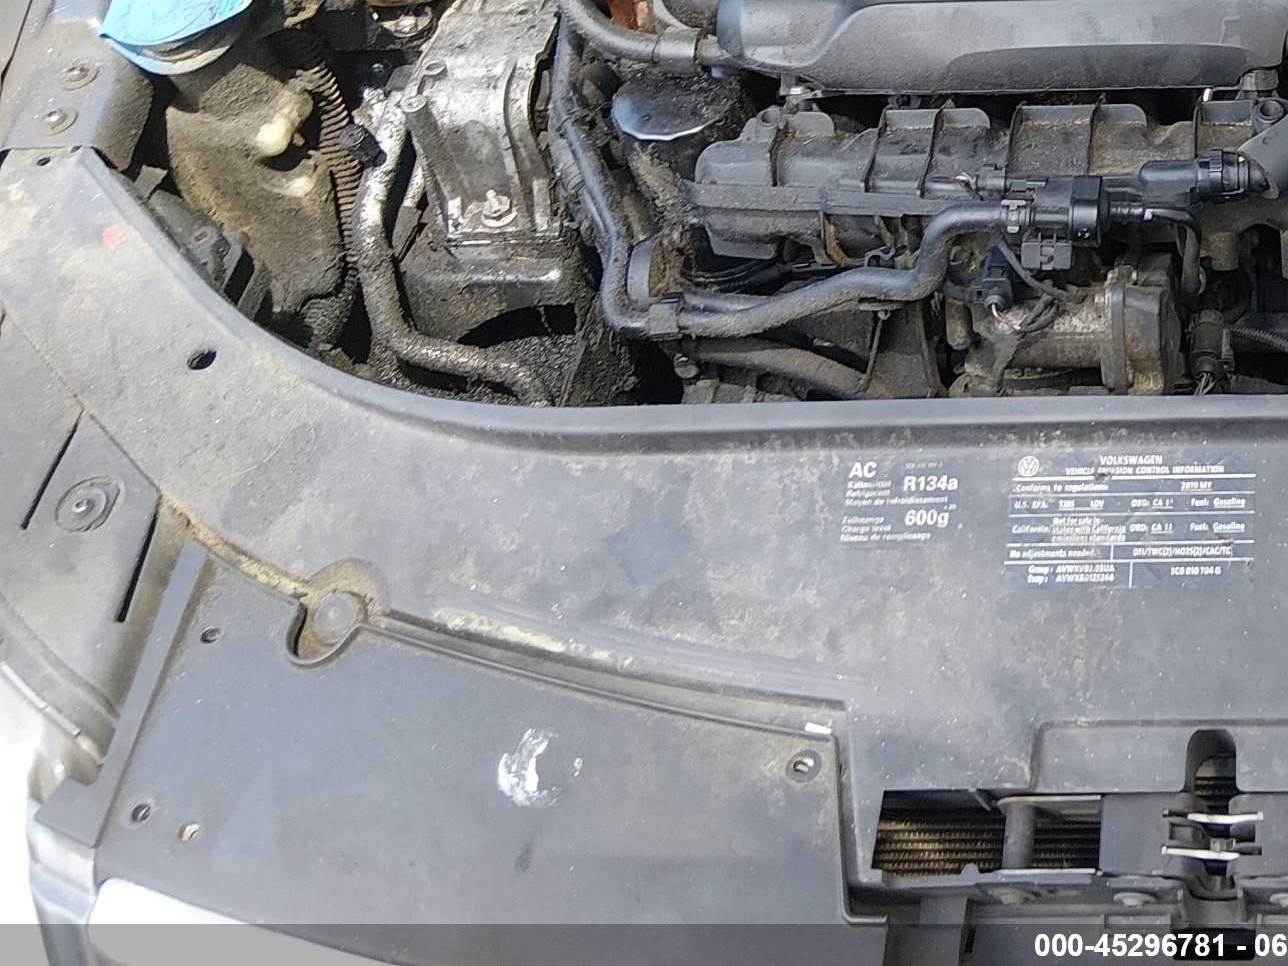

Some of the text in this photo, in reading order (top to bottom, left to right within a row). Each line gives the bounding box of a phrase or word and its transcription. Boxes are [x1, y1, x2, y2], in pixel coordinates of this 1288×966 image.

[1099, 455, 1163, 465] VOLKSWAGEN
[849, 461, 877, 478] AC
[1065, 467, 1095, 475] VEHICLE
[1135, 465, 1170, 474] CONTROL
[1172, 465, 1225, 473] INFORMATION
[903, 475, 959, 492] R134a
[1180, 481, 1199, 490] 2010
[904, 509, 950, 528] 600g
[1130, 523, 1149, 532] OBD:
[1151, 523, 1162, 531] CA
[1190, 522, 1209, 531] Fuel:
[1213, 522, 1246, 531] Gasoline
[1185, 566, 1199, 575] 010
